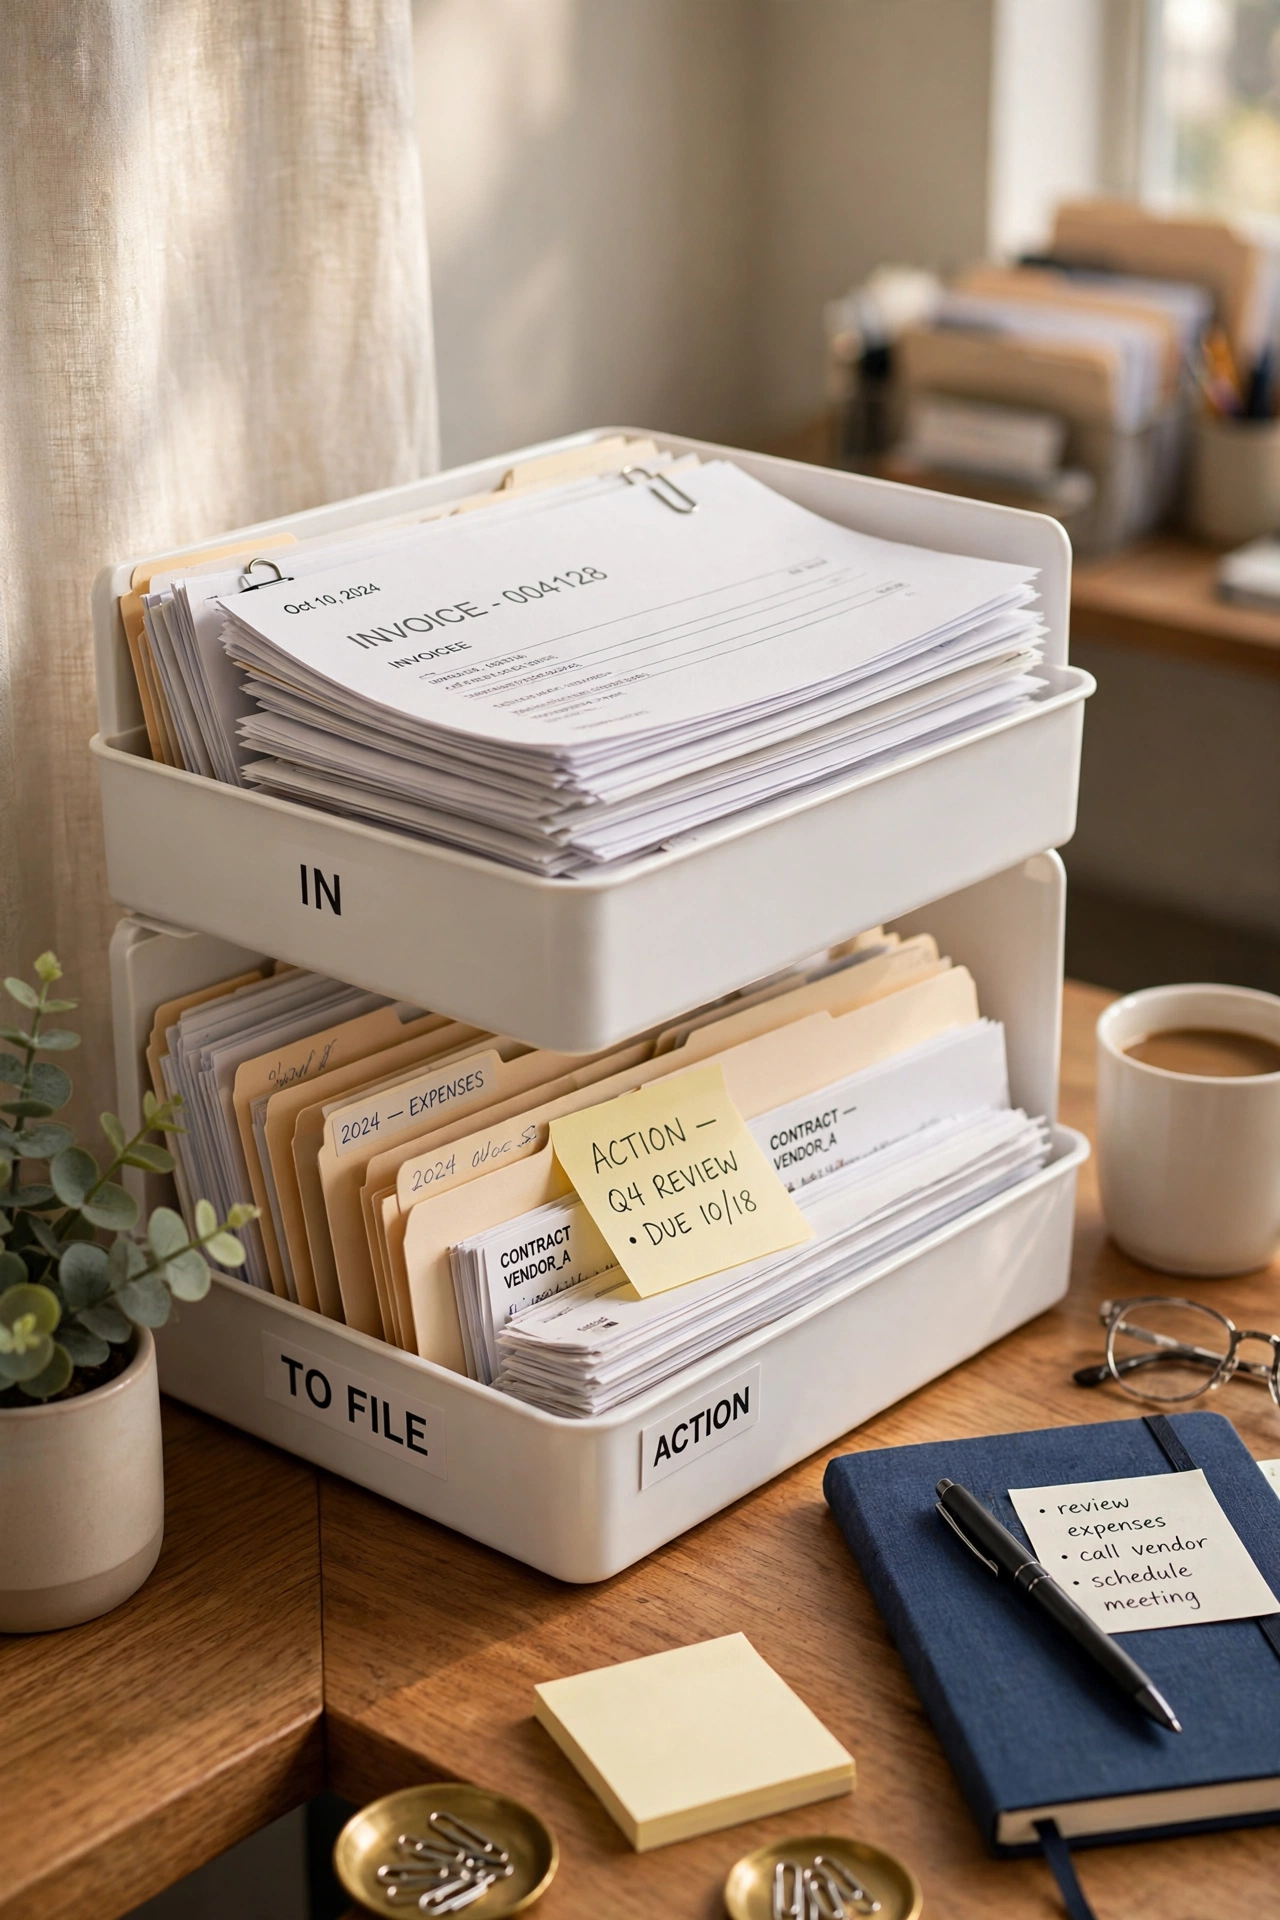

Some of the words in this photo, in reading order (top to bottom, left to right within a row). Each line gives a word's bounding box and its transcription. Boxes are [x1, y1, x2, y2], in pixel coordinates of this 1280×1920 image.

[283, 598, 313, 615] Oct
[315, 594, 344, 609] 10,
[343, 583, 381, 601] 2024
[346, 601, 489, 649] INVOICE
[501, 566, 608, 604] 004128
[388, 641, 473, 669] INVOICEE
[300, 863, 342, 916] IN
[341, 1111, 381, 1145] 2024
[409, 1070, 485, 1117] EXPENSES
[592, 1117, 687, 1174] ACTION
[770, 1108, 838, 1151] CONTRACT
[773, 1132, 838, 1171] VENDOR_A
[412, 1154, 456, 1191] 2024
[608, 1181, 644, 1213] Q4
[652, 1150, 739, 1199] REVIEW
[642, 1212, 692, 1247] DUE
[699, 1189, 758, 1226] 10/18
[500, 1225, 571, 1268] CONTRACT
[503, 1249, 572, 1289] VENDOR_A
[281, 1354, 332, 1409] TO
[347, 1384, 428, 1456] FILE
[653, 1386, 750, 1468] ACTION
[1057, 1498, 1130, 1515] review
[1068, 1516, 1167, 1539] expenses
[1080, 1544, 1120, 1562] call
[1131, 1535, 1209, 1556] vendor
[1091, 1562, 1193, 1588] schedule
[1103, 1590, 1201, 1611] meeting
